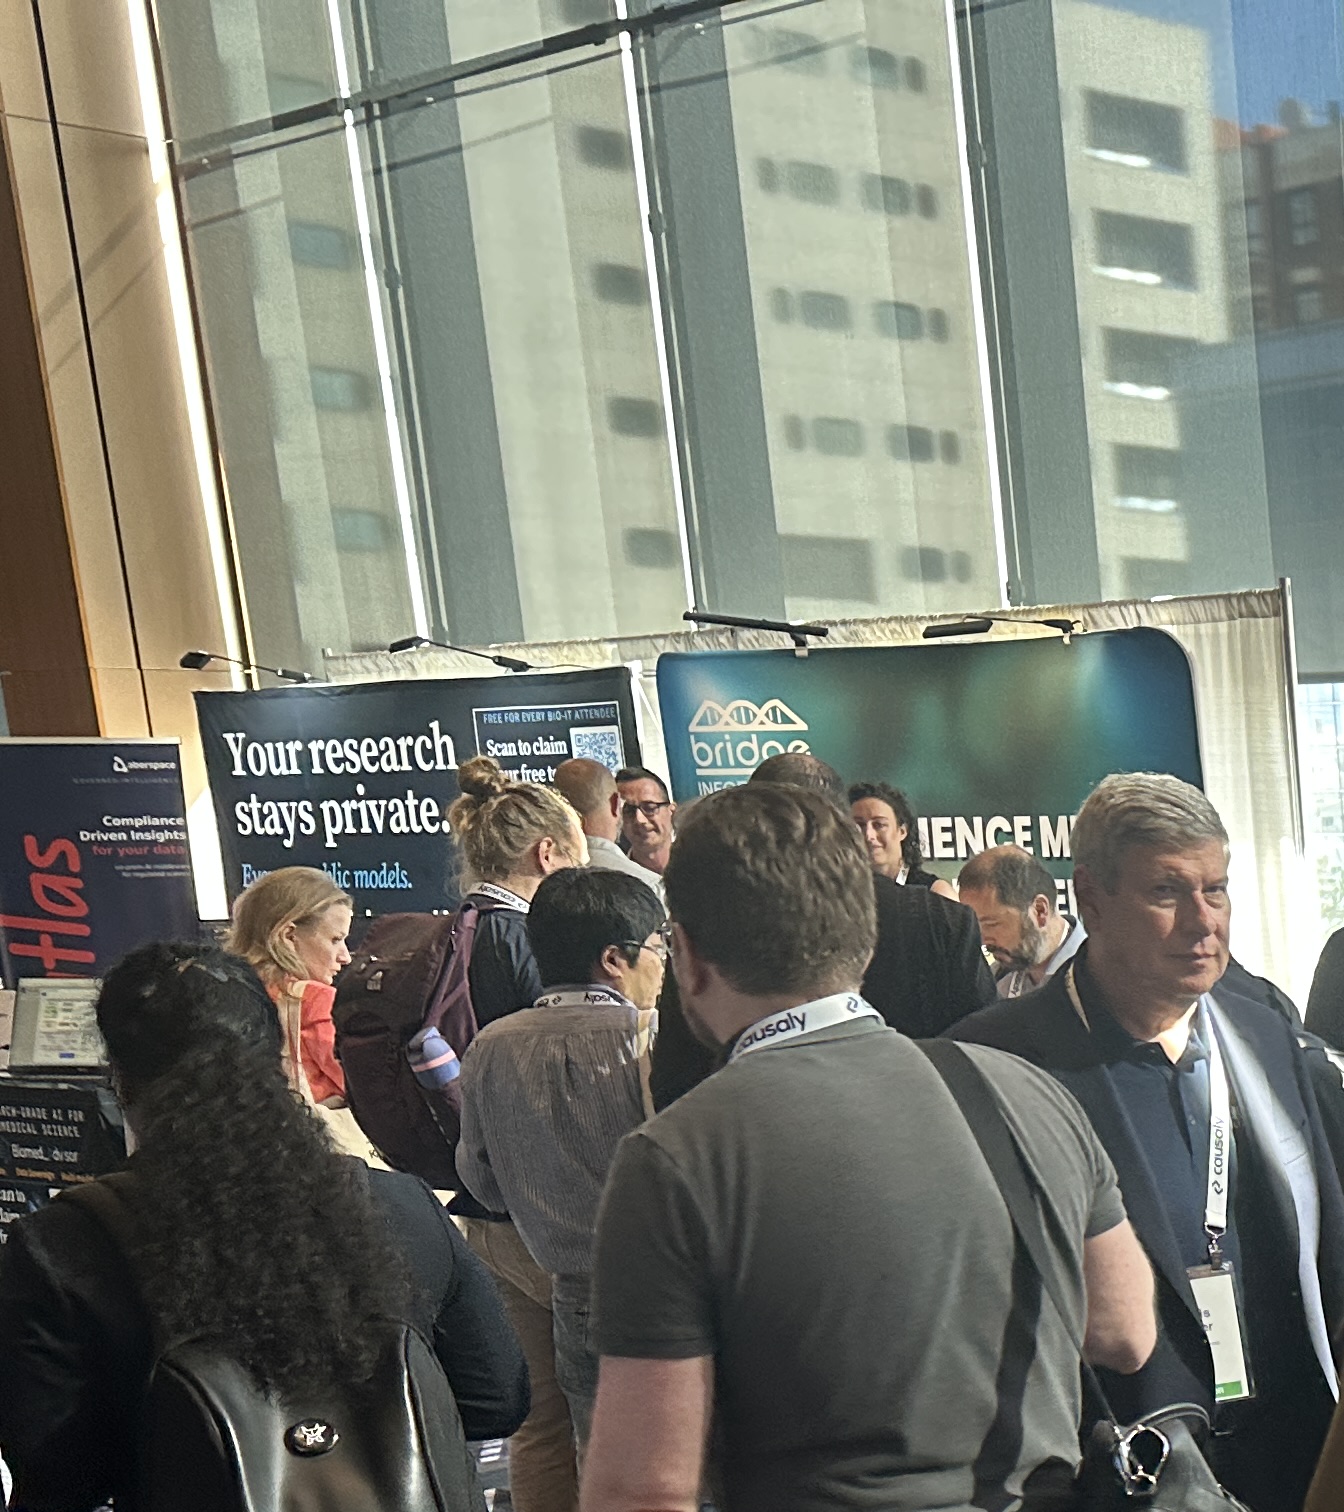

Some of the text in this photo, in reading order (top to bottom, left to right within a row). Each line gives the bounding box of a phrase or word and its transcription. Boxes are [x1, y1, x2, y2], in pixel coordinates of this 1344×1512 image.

[483, 712, 502, 724] FREE
[504, 712, 520, 723] FOR
[522, 711, 545, 722] EVERY
[574, 707, 616, 720] ATTENDEE
[223, 720, 459, 776] Your research
[486, 736, 568, 757] Scan to claim
[521, 763, 546, 783] free
[102, 815, 185, 828] Compliance
[235, 783, 450, 848] stays private.
[79, 829, 187, 842] Driven Insights
[918, 815, 1034, 859] IENCE
[92, 845, 112, 855] for
[118, 846, 148, 857] your
[354, 862, 413, 889] models.
[0, 834, 97, 977] tlas
[68, 1110, 86, 1123] FOR
[0, 1121, 81, 1138] MEDICAL SCIENCE
[1212, 1116, 1225, 1175] causaly
